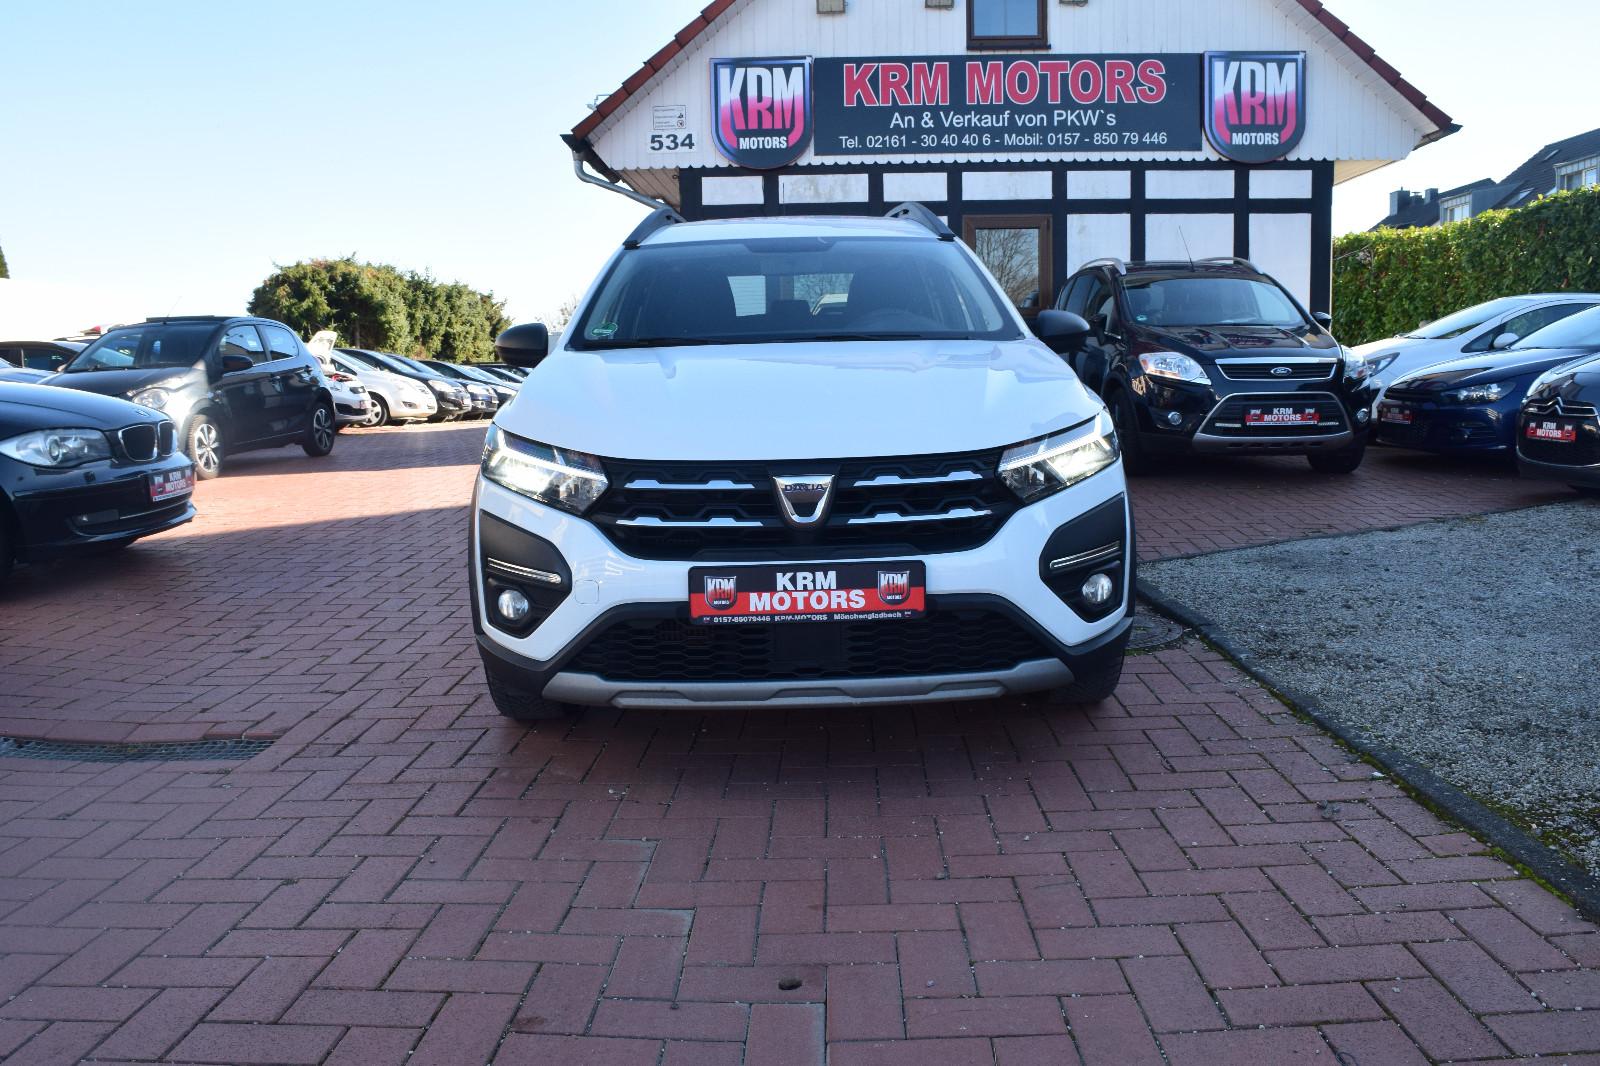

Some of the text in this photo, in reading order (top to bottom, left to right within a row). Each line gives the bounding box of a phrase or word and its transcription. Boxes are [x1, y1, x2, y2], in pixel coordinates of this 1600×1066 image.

[843, 60, 1167, 107] KRM MOTORS
[720, 67, 804, 148] KRM
[1214, 61, 1296, 144] KRM
[890, 112, 915, 128] An
[921, 111, 934, 128] &
[940, 110, 1011, 128] Verkauf
[1015, 113, 1047, 127] von
[650, 133, 695, 151] 534
[739, 136, 787, 150] MOTORS
[838, 136, 862, 149] Tel.
[866, 136, 906, 148] 02161
[920, 135, 937, 147] 30
[941, 134, 958, 147] 40
[962, 134, 979, 146] 40
[982, 134, 991, 146] 6
[1004, 133, 1043, 146] Mobil:
[1047, 133, 1080, 145] 0157
[1093, 132, 1118, 145] 850
[1122, 132, 1139, 145] 79
[1142, 132, 1168, 145] 446
[1232, 132, 1279, 145] MOTORS
[1264, 414, 1301, 422] MOTORS
[1536, 428, 1562, 438] MOTORS
[776, 571, 837, 592] KRM
[749, 589, 866, 612] MOTORS
